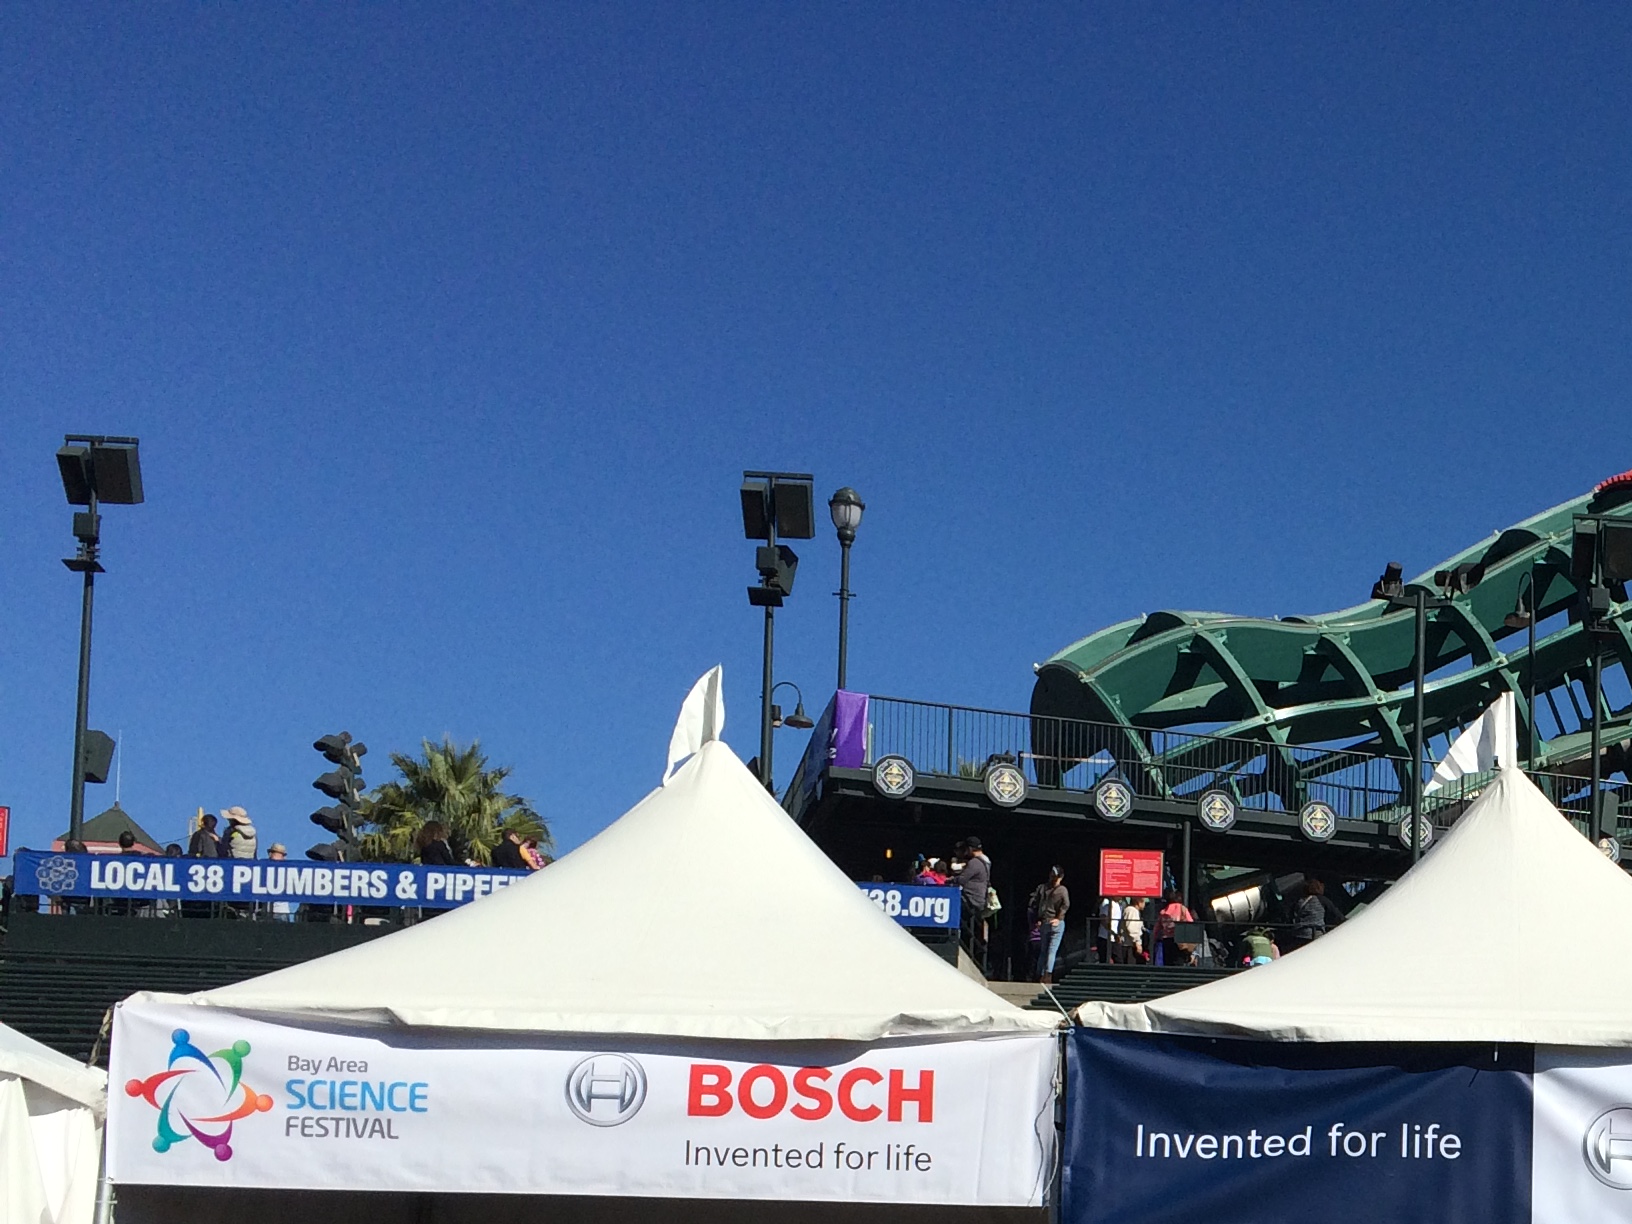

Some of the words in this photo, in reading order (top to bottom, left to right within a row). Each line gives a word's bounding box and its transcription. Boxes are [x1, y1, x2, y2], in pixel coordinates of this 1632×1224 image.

[90, 861, 181, 892] LOCAL
[188, 864, 224, 893] 38
[232, 866, 388, 898] PLUMBERS
[396, 870, 418, 899] &
[287, 1055, 322, 1076] Bay
[325, 1056, 369, 1073] Area
[285, 1079, 429, 1113] SCIENCE
[687, 1063, 935, 1123] BOSCH
[285, 1116, 399, 1140] FESTIVAL
[1135, 1124, 1313, 1160] Invented
[1327, 1122, 1387, 1158] for
[1401, 1122, 1463, 1160] life
[685, 1139, 824, 1169] Invented
[833, 1142, 879, 1170] for
[886, 1143, 933, 1172] life
